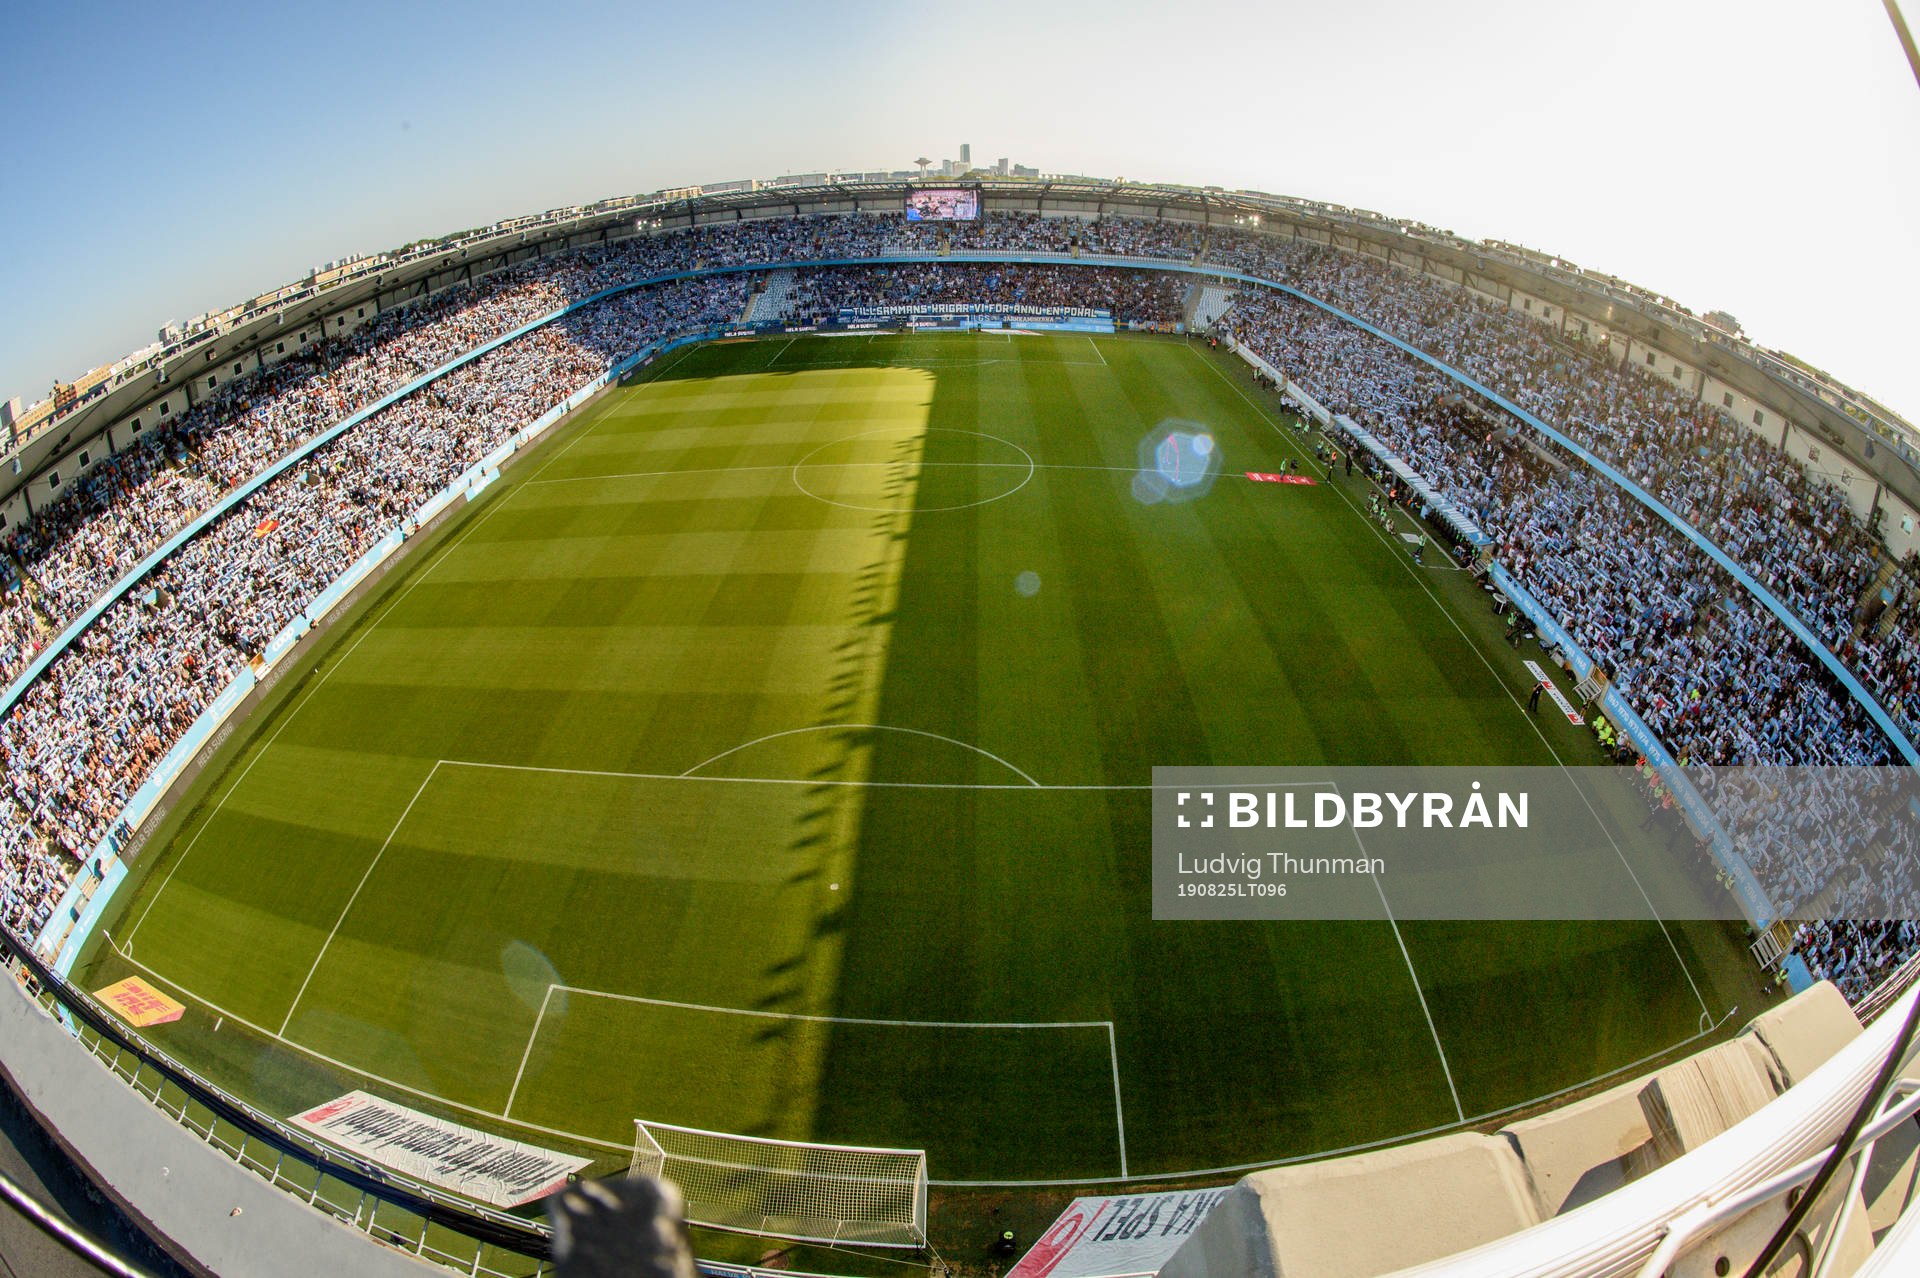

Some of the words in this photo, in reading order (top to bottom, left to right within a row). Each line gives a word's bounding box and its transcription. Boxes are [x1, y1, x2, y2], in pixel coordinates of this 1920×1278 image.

[852, 304, 928, 316] TILLSAMMANS
[974, 303, 985, 313] VI
[1046, 306, 1060, 316] EN
[1092, 1194, 1175, 1242] SPEL
